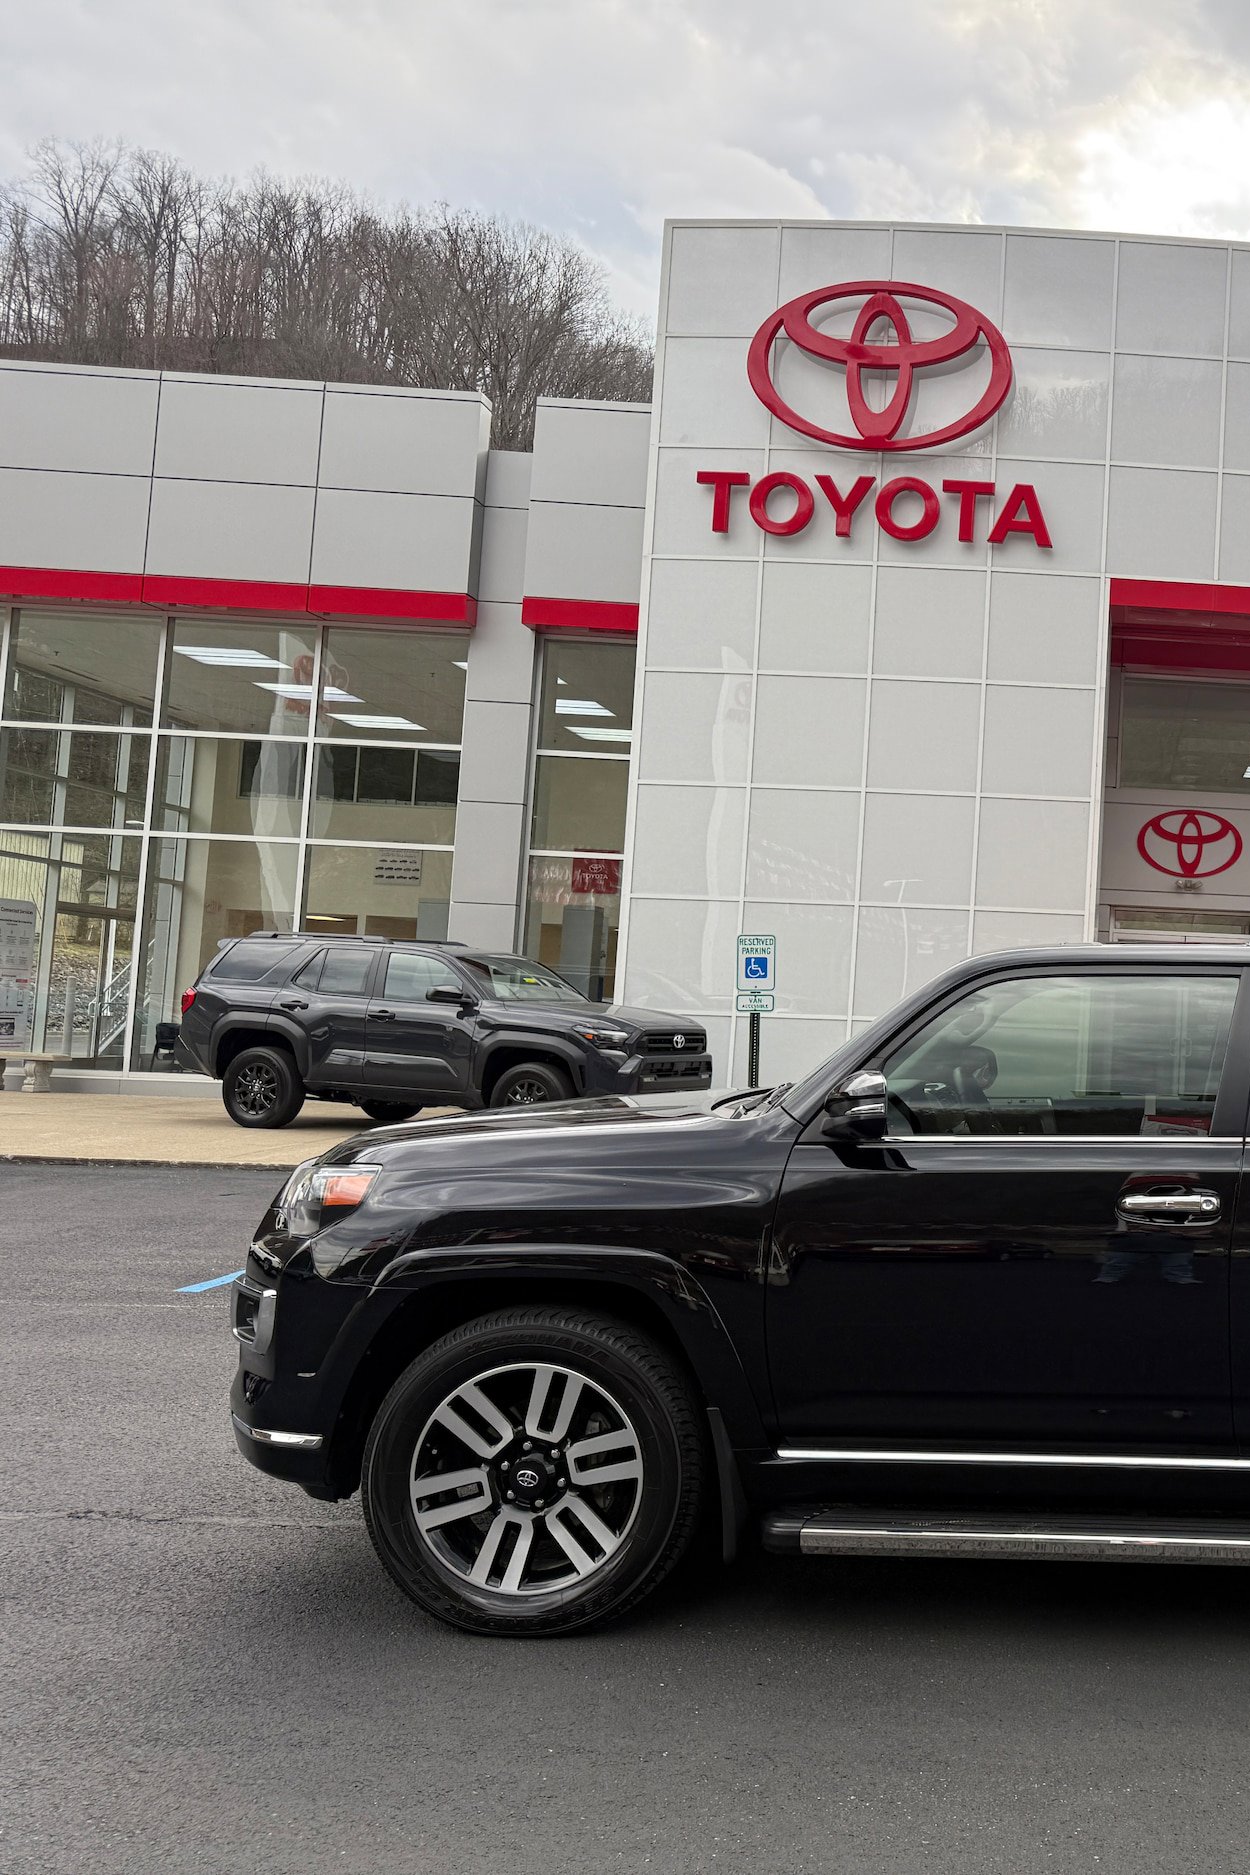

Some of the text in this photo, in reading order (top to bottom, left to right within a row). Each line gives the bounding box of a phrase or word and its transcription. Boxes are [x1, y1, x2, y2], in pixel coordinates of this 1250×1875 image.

[697, 471, 1053, 549] TOYOTA
[740, 938, 774, 946] RESERVED
[741, 947, 771, 955] PARKING
